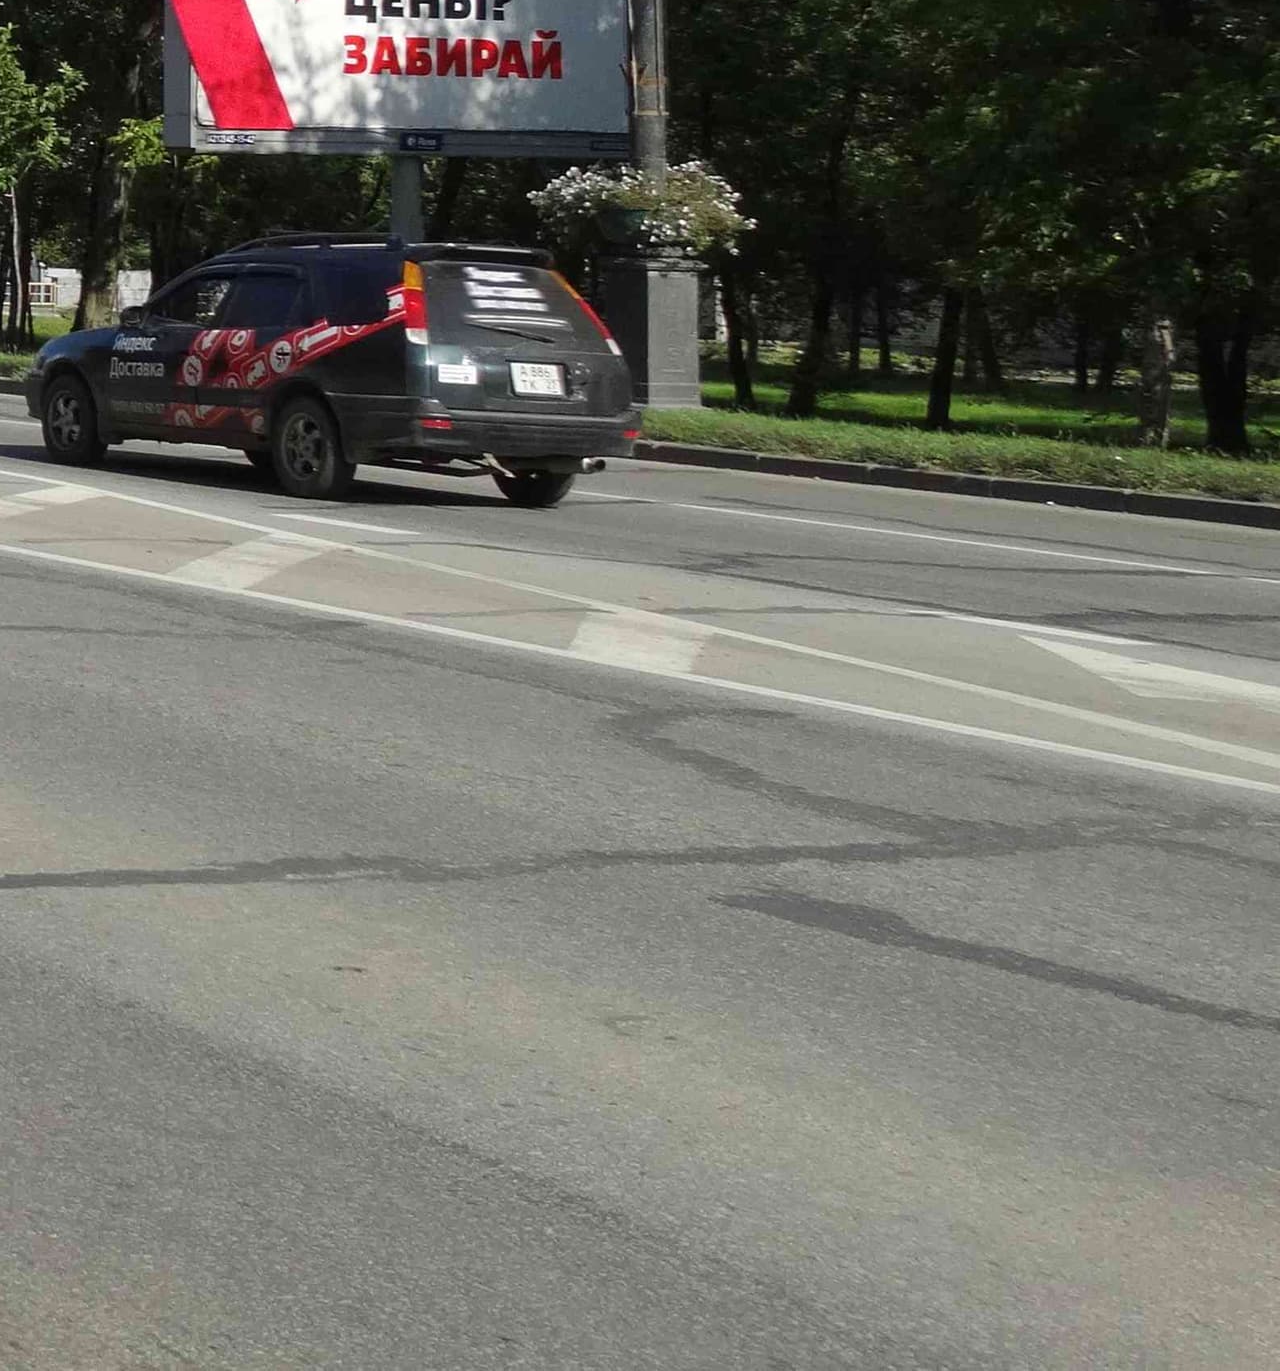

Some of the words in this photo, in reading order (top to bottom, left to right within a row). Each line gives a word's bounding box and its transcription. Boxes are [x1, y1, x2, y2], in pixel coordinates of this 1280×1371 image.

[343, 30, 563, 79] ЗАБИРАЙ
[113, 333, 157, 353] Яндекс
[109, 357, 165, 379] Доставка
